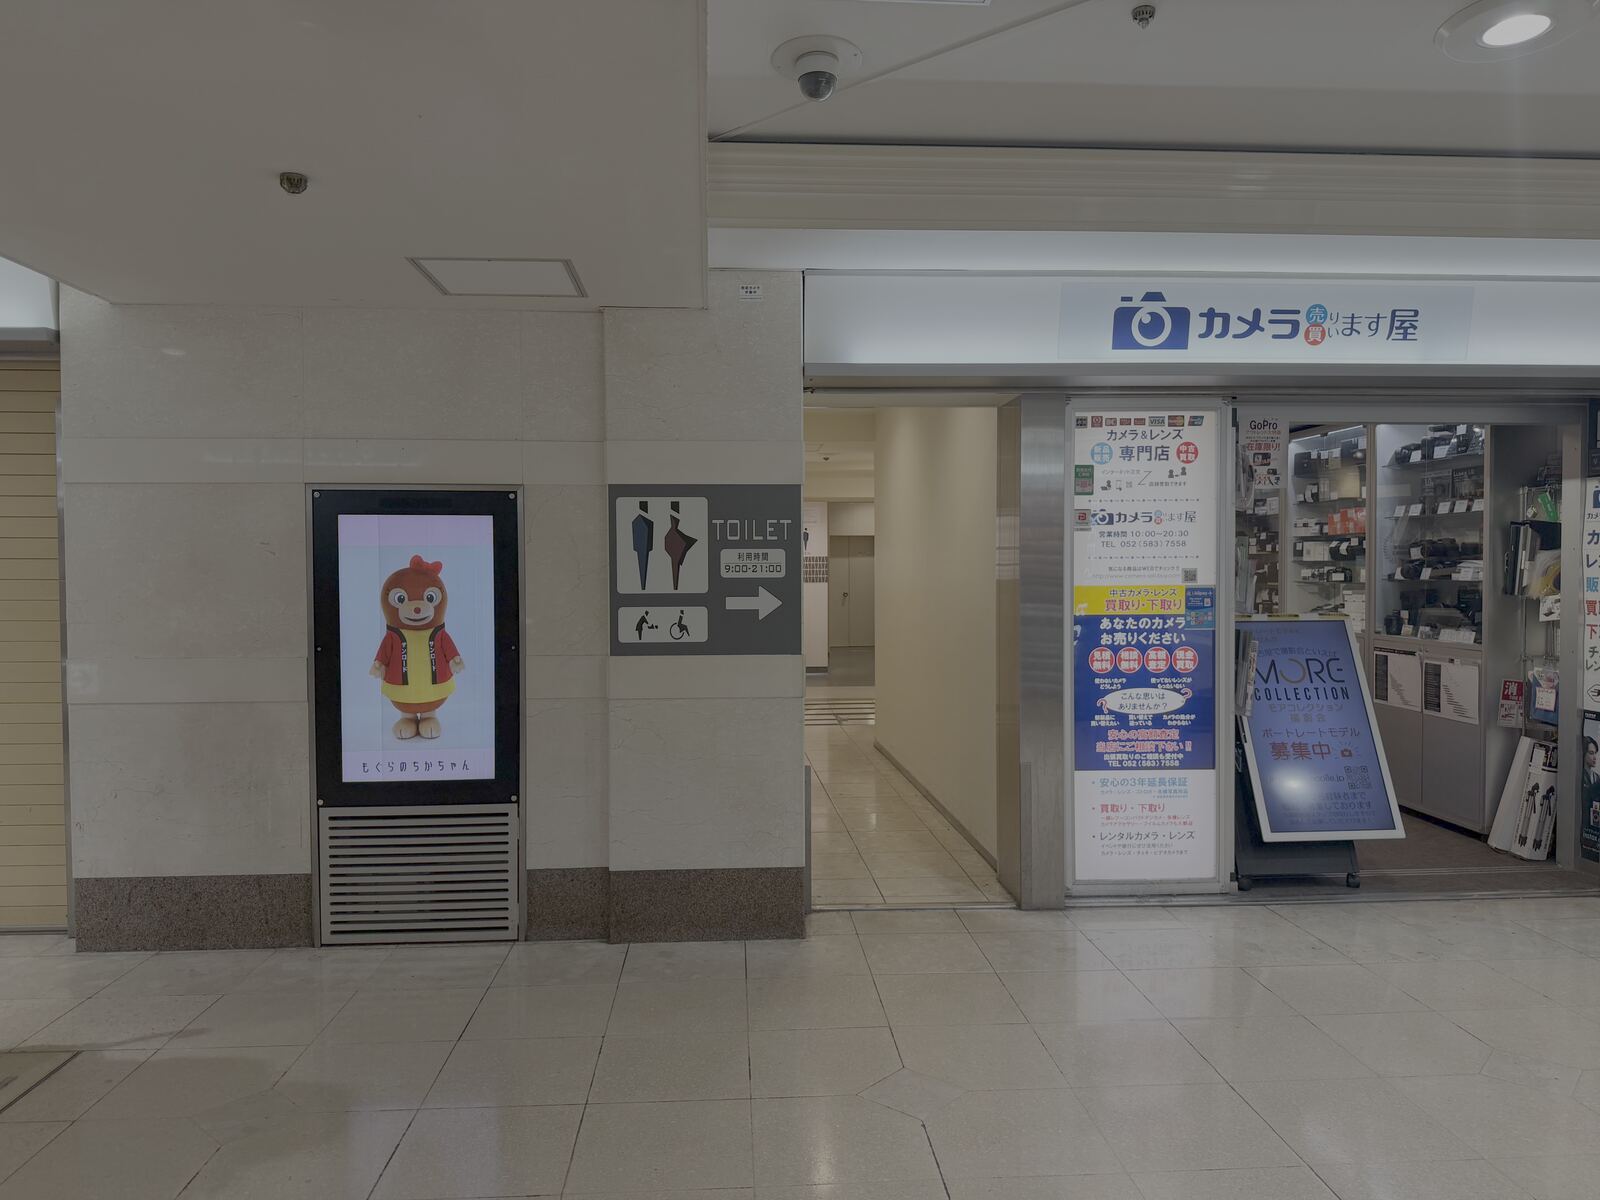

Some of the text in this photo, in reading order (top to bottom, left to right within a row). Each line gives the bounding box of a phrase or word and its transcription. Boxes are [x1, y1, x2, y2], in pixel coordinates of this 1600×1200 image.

[1198, 307, 1302, 339] カメラ
[1250, 420, 1278, 431] GoPro
[1107, 429, 1184, 441] カメラ&レンズ
[1119, 446, 1170, 461] 専門店
[1115, 511, 1153, 523] カメラ
[712, 519, 792, 541] TOILET
[737, 552, 769, 562] 利用時間
[1105, 599, 1182, 612] 買取り・下取り
[1099, 617, 1186, 630] あなたのカメラ
[1099, 632, 1186, 645] お売りください
[1254, 658, 1346, 685] MORE
[1254, 686, 1350, 701] COLLECTION
[1262, 727, 1361, 739] ポートレートモデル
[1269, 741, 1331, 761] 募集中
[1099, 777, 1188, 788] 安心の3年延長保証
[1100, 803, 1165, 813] 買取り・下取り
[1099, 831, 1195, 841] レンタルカメラ・レンズ
